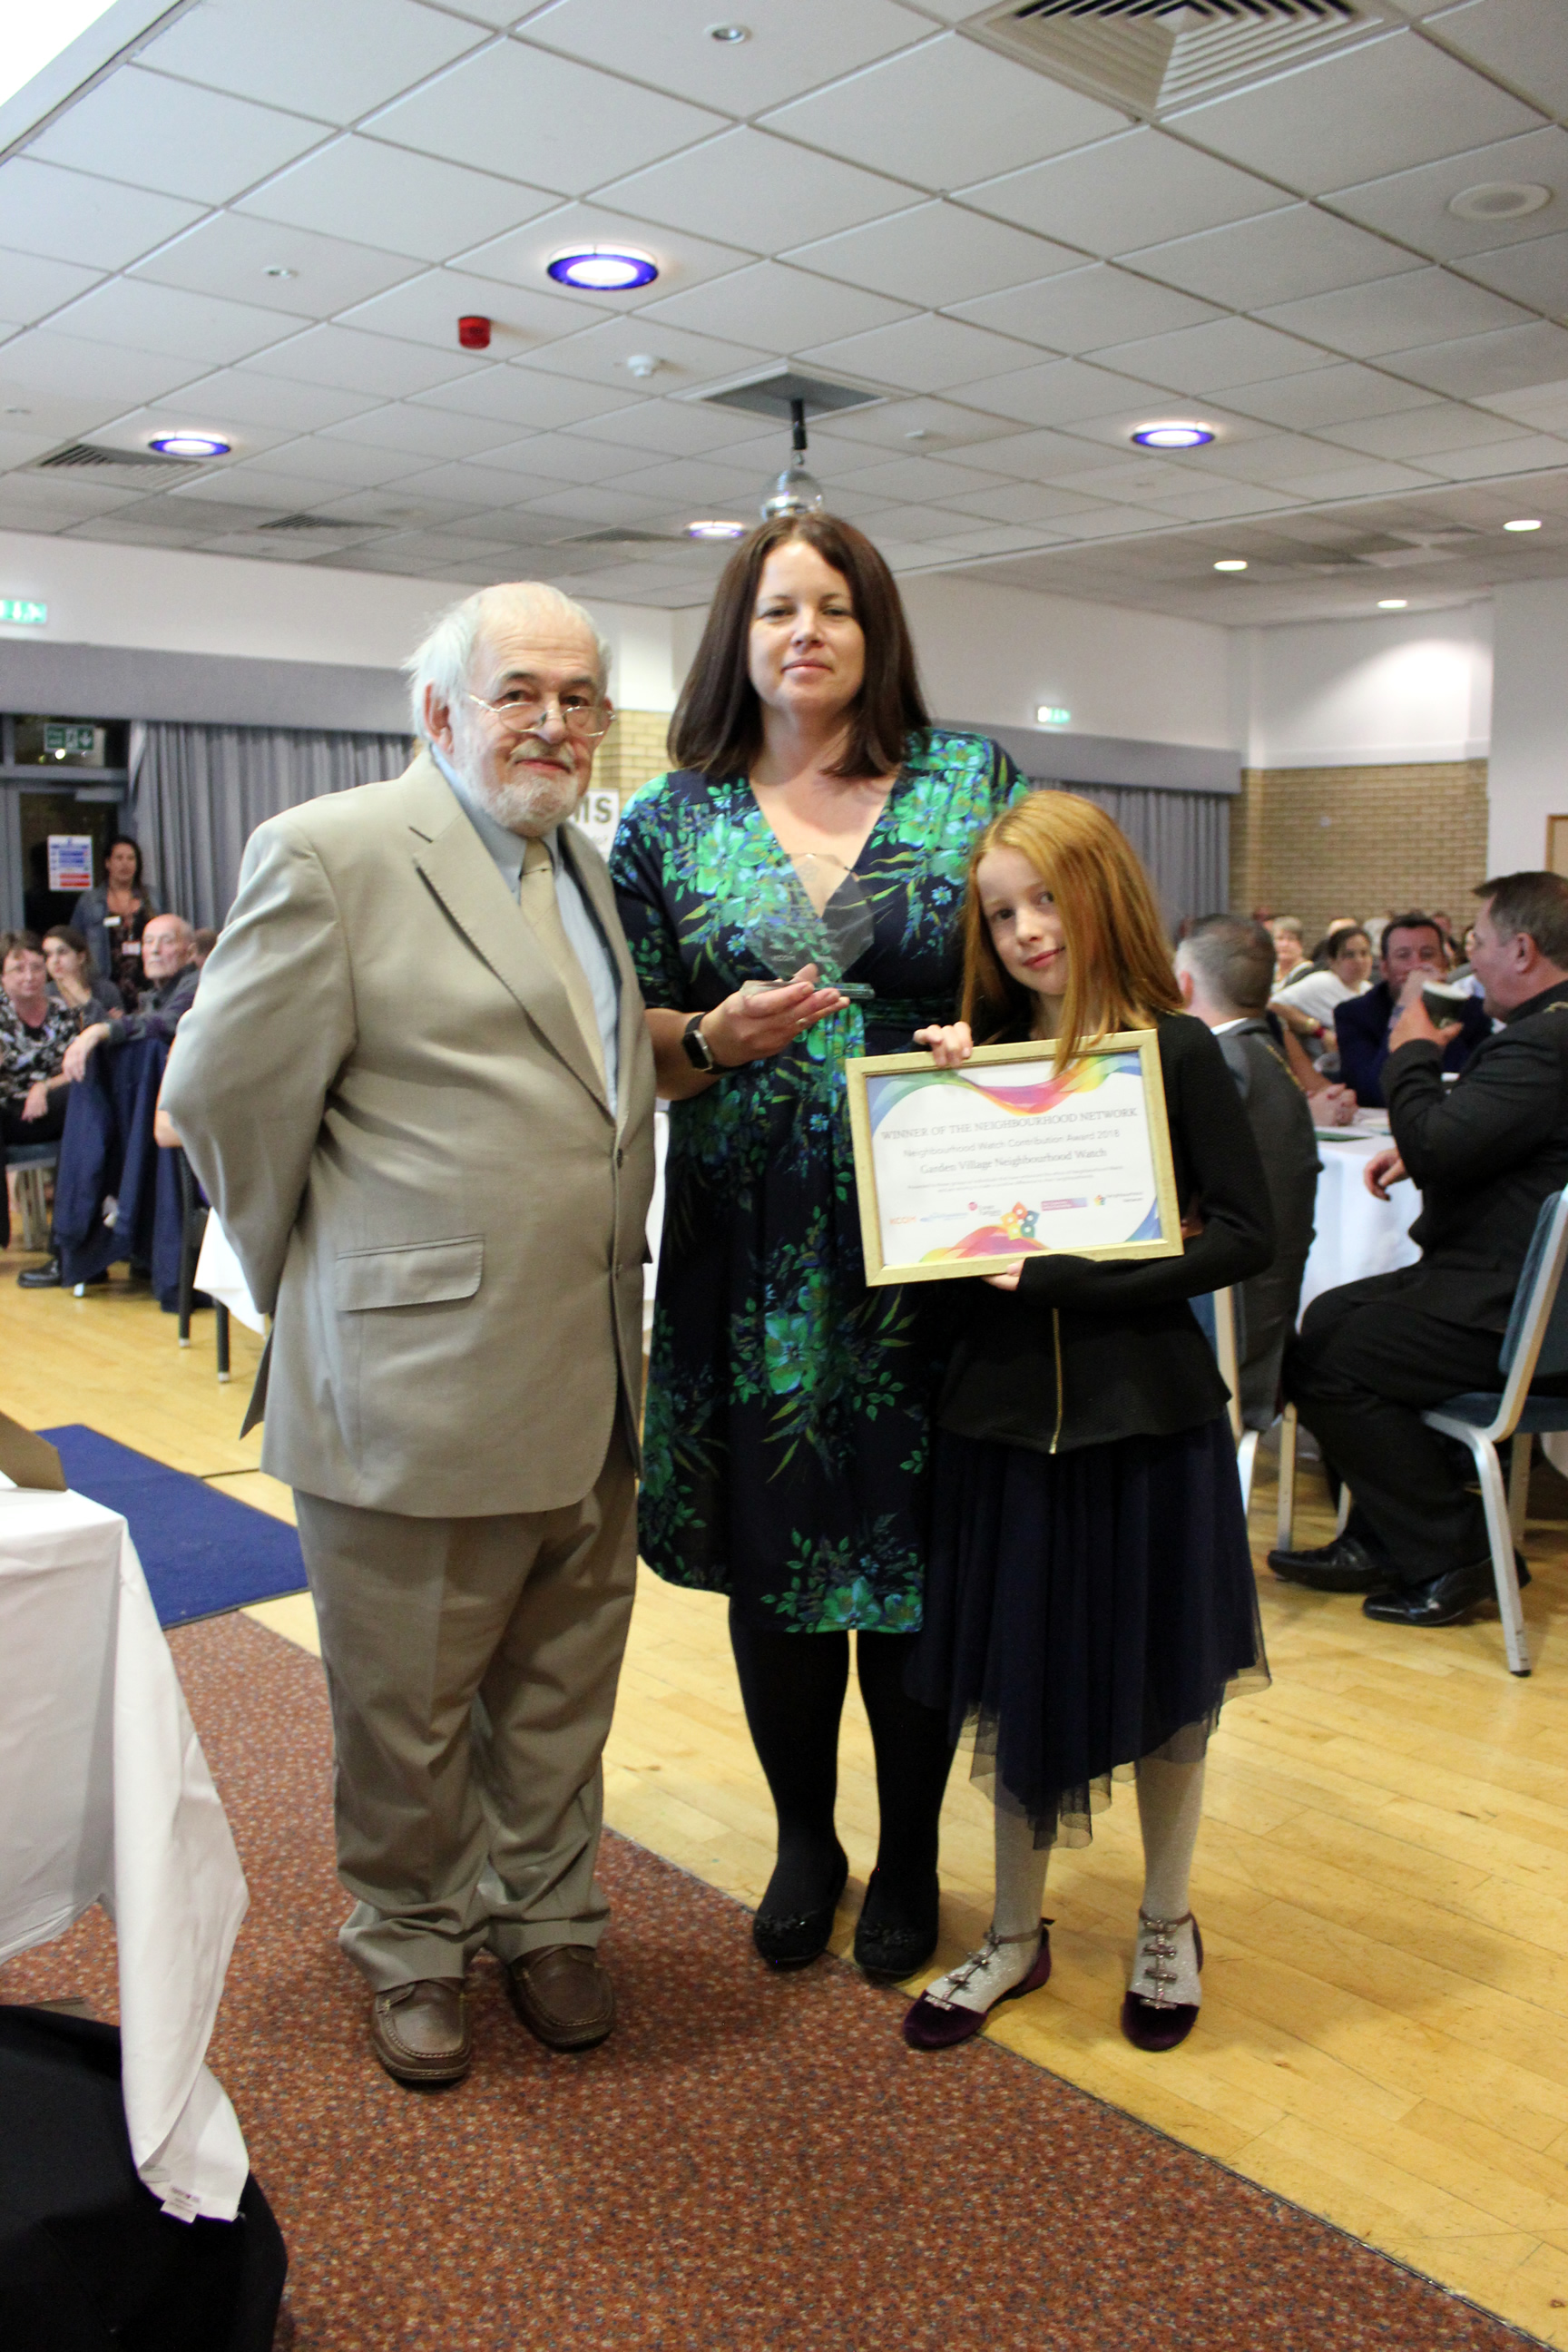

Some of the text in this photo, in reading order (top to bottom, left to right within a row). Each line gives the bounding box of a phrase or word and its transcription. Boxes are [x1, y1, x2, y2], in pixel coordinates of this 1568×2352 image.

[880, 1107, 1138, 1140] WINNER OF THE NEIGHBOURHOOD NETWORK
[903, 1142, 975, 1158] Neighbourhood
[1008, 1135, 1063, 1148] Contribution
[1066, 1132, 1094, 1142] Award
[1097, 1129, 1120, 1140] 2018
[920, 1148, 1107, 1174] Garden Village Neighbourhood Watch
